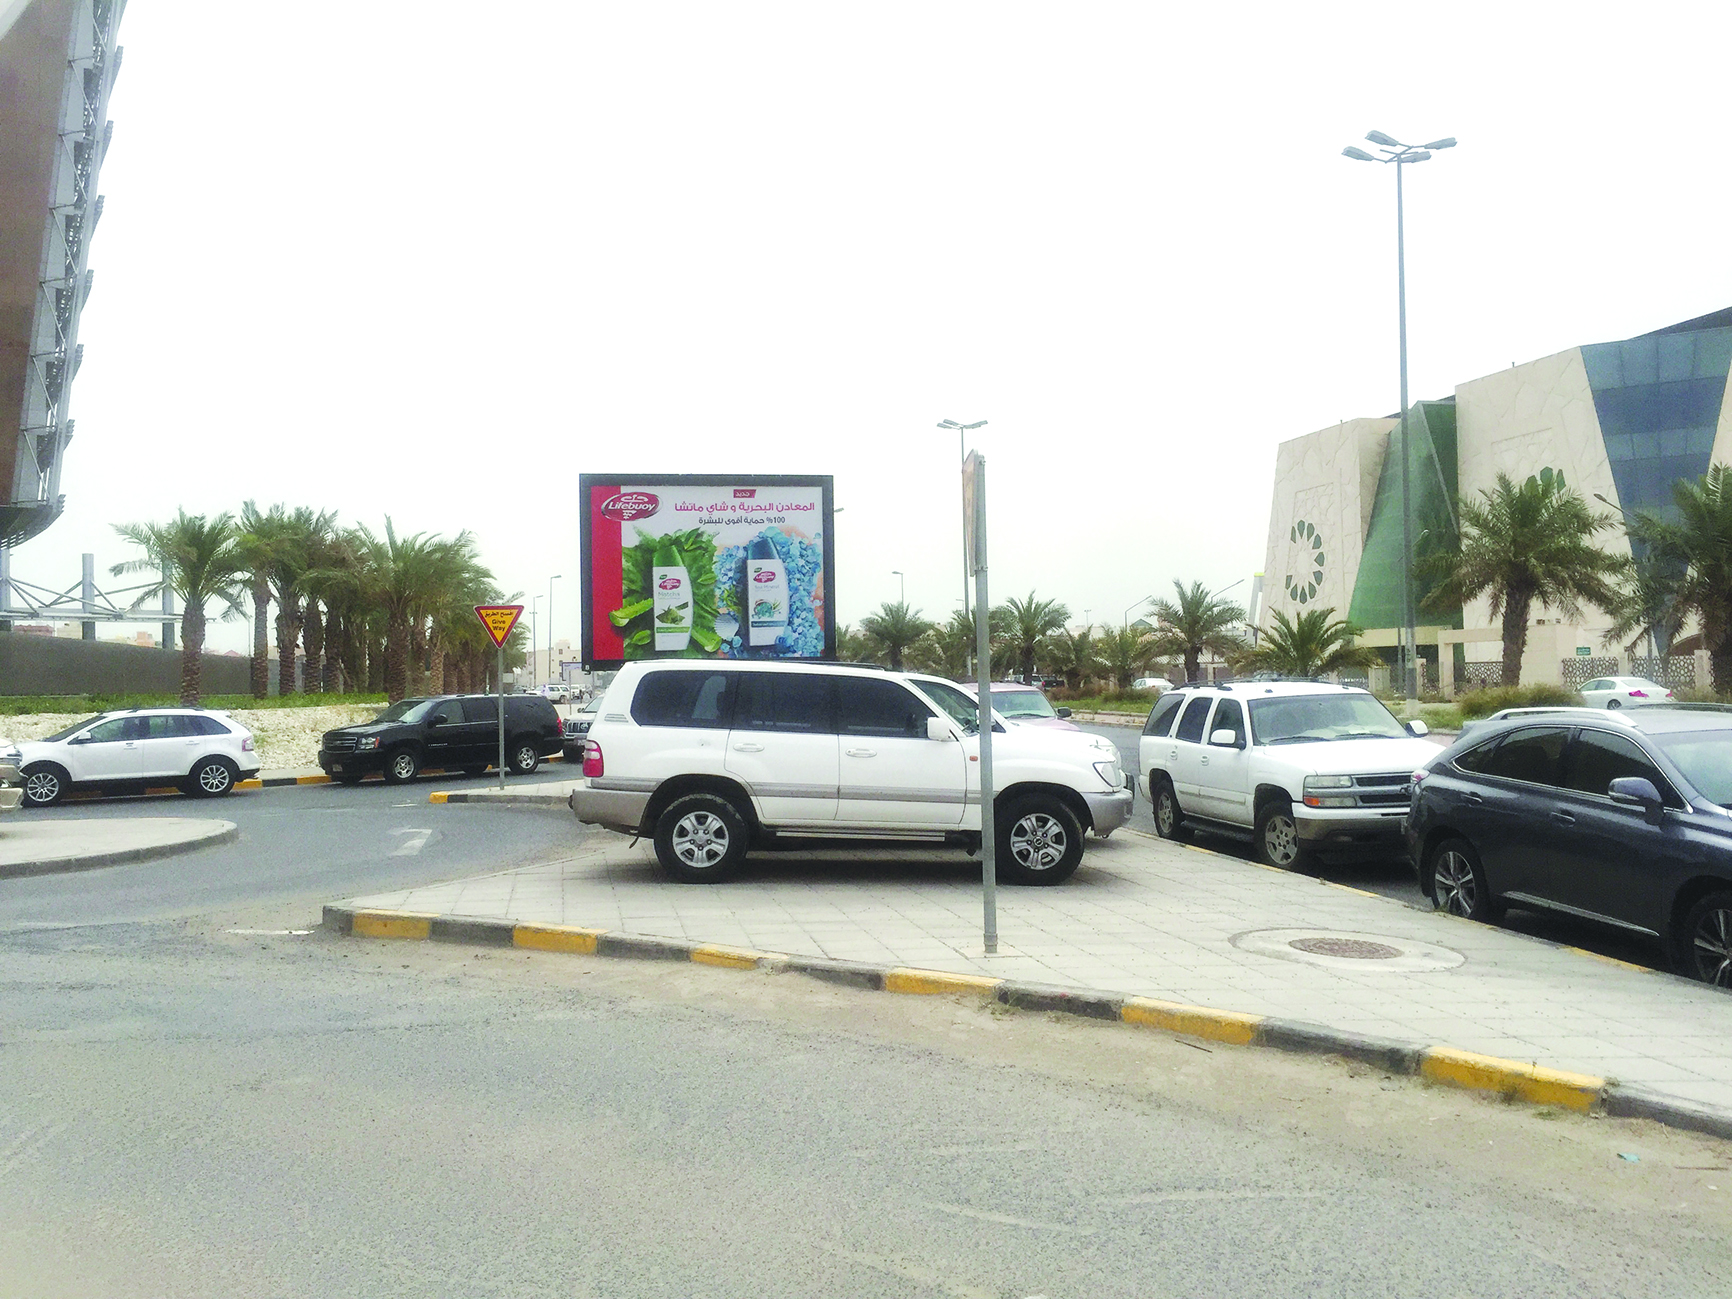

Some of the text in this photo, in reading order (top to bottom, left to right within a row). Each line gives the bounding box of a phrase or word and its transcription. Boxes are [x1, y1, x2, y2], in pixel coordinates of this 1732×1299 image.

[608, 501, 656, 512] Lifebuoy
[674, 501, 815, 516] المعادن البحرية و شاي ماتشا
[698, 515, 724, 526] للبشرة
[743, 515, 765, 526] حماية
